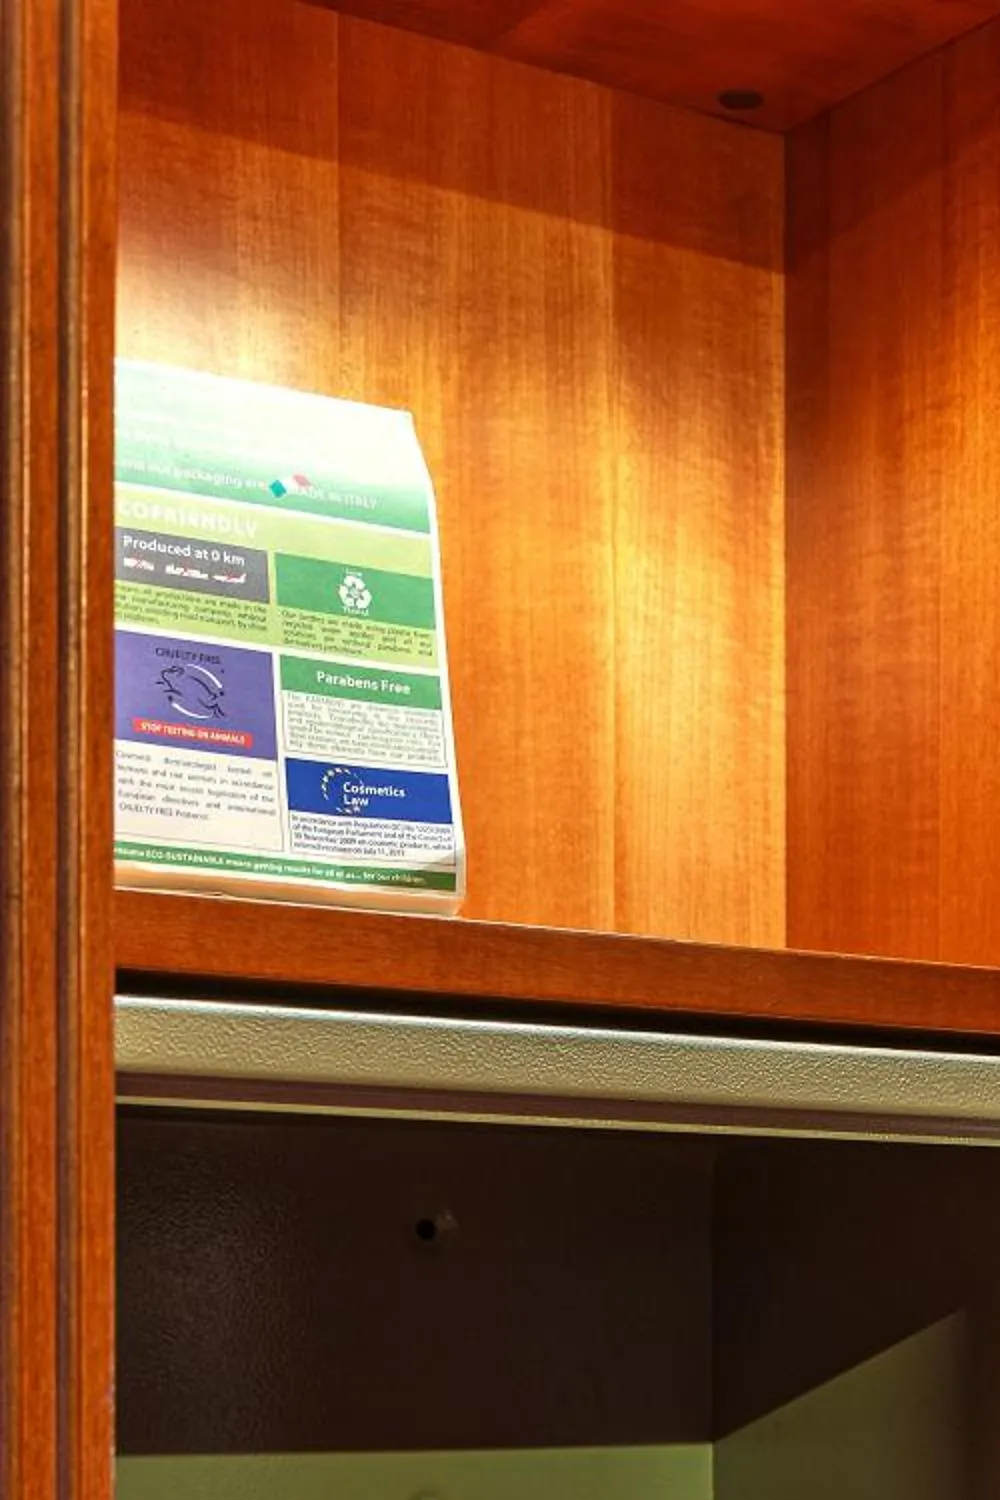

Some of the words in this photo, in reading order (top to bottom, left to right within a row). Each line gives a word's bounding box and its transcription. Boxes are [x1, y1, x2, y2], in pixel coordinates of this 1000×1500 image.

[122, 535, 191, 557] Produced
[195, 550, 209, 561] at
[211, 549, 221, 561] 0
[223, 551, 246, 567] km
[316, 671, 379, 691] Parabens
[381, 680, 412, 695] Free
[343, 781, 406, 798] Cosmetics
[343, 794, 369, 806] Law
